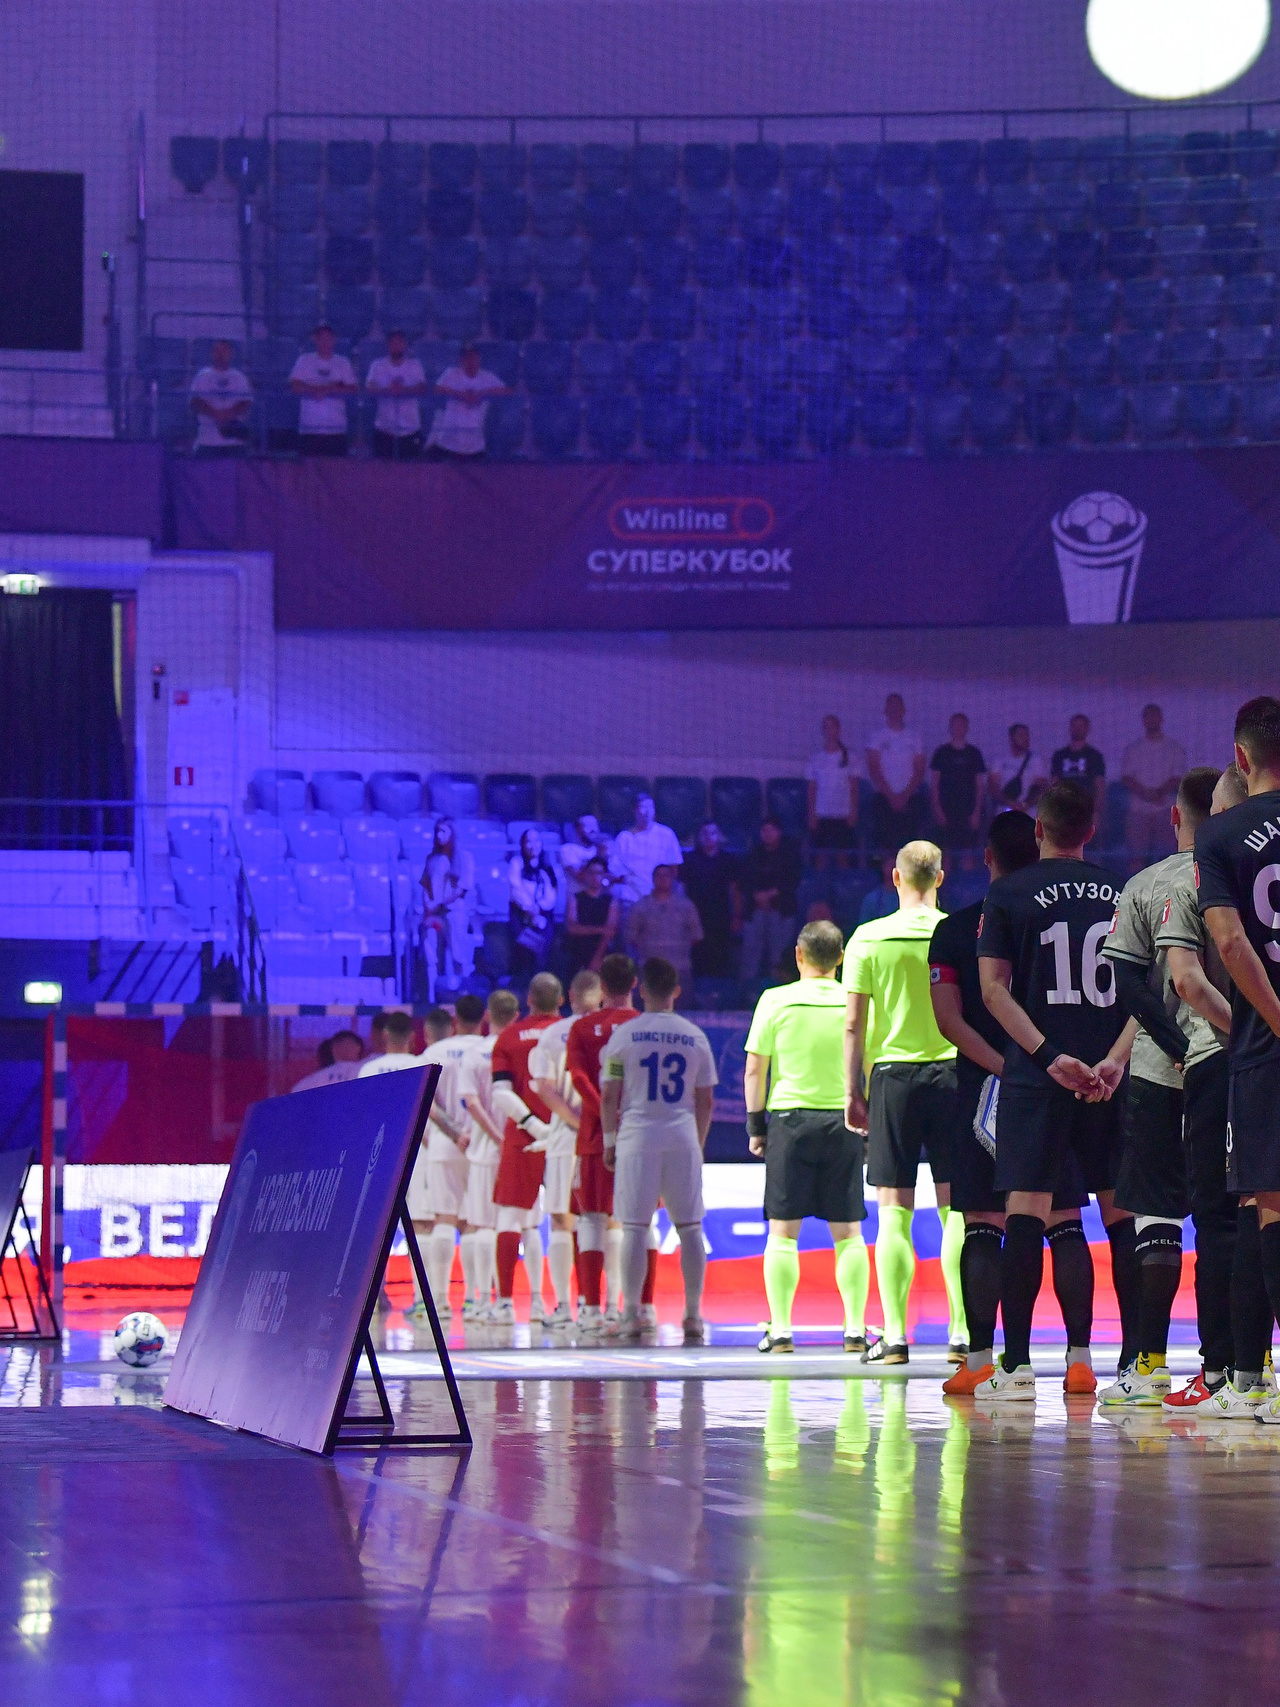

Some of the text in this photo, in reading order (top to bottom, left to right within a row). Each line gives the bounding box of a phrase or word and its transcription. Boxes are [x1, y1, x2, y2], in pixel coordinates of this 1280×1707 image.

[623, 507, 727, 530] Winline
[587, 549, 792, 573] СУПЕРКУБОК
[1040, 921, 1116, 1007] 16
[639, 1051, 687, 1103] 13
